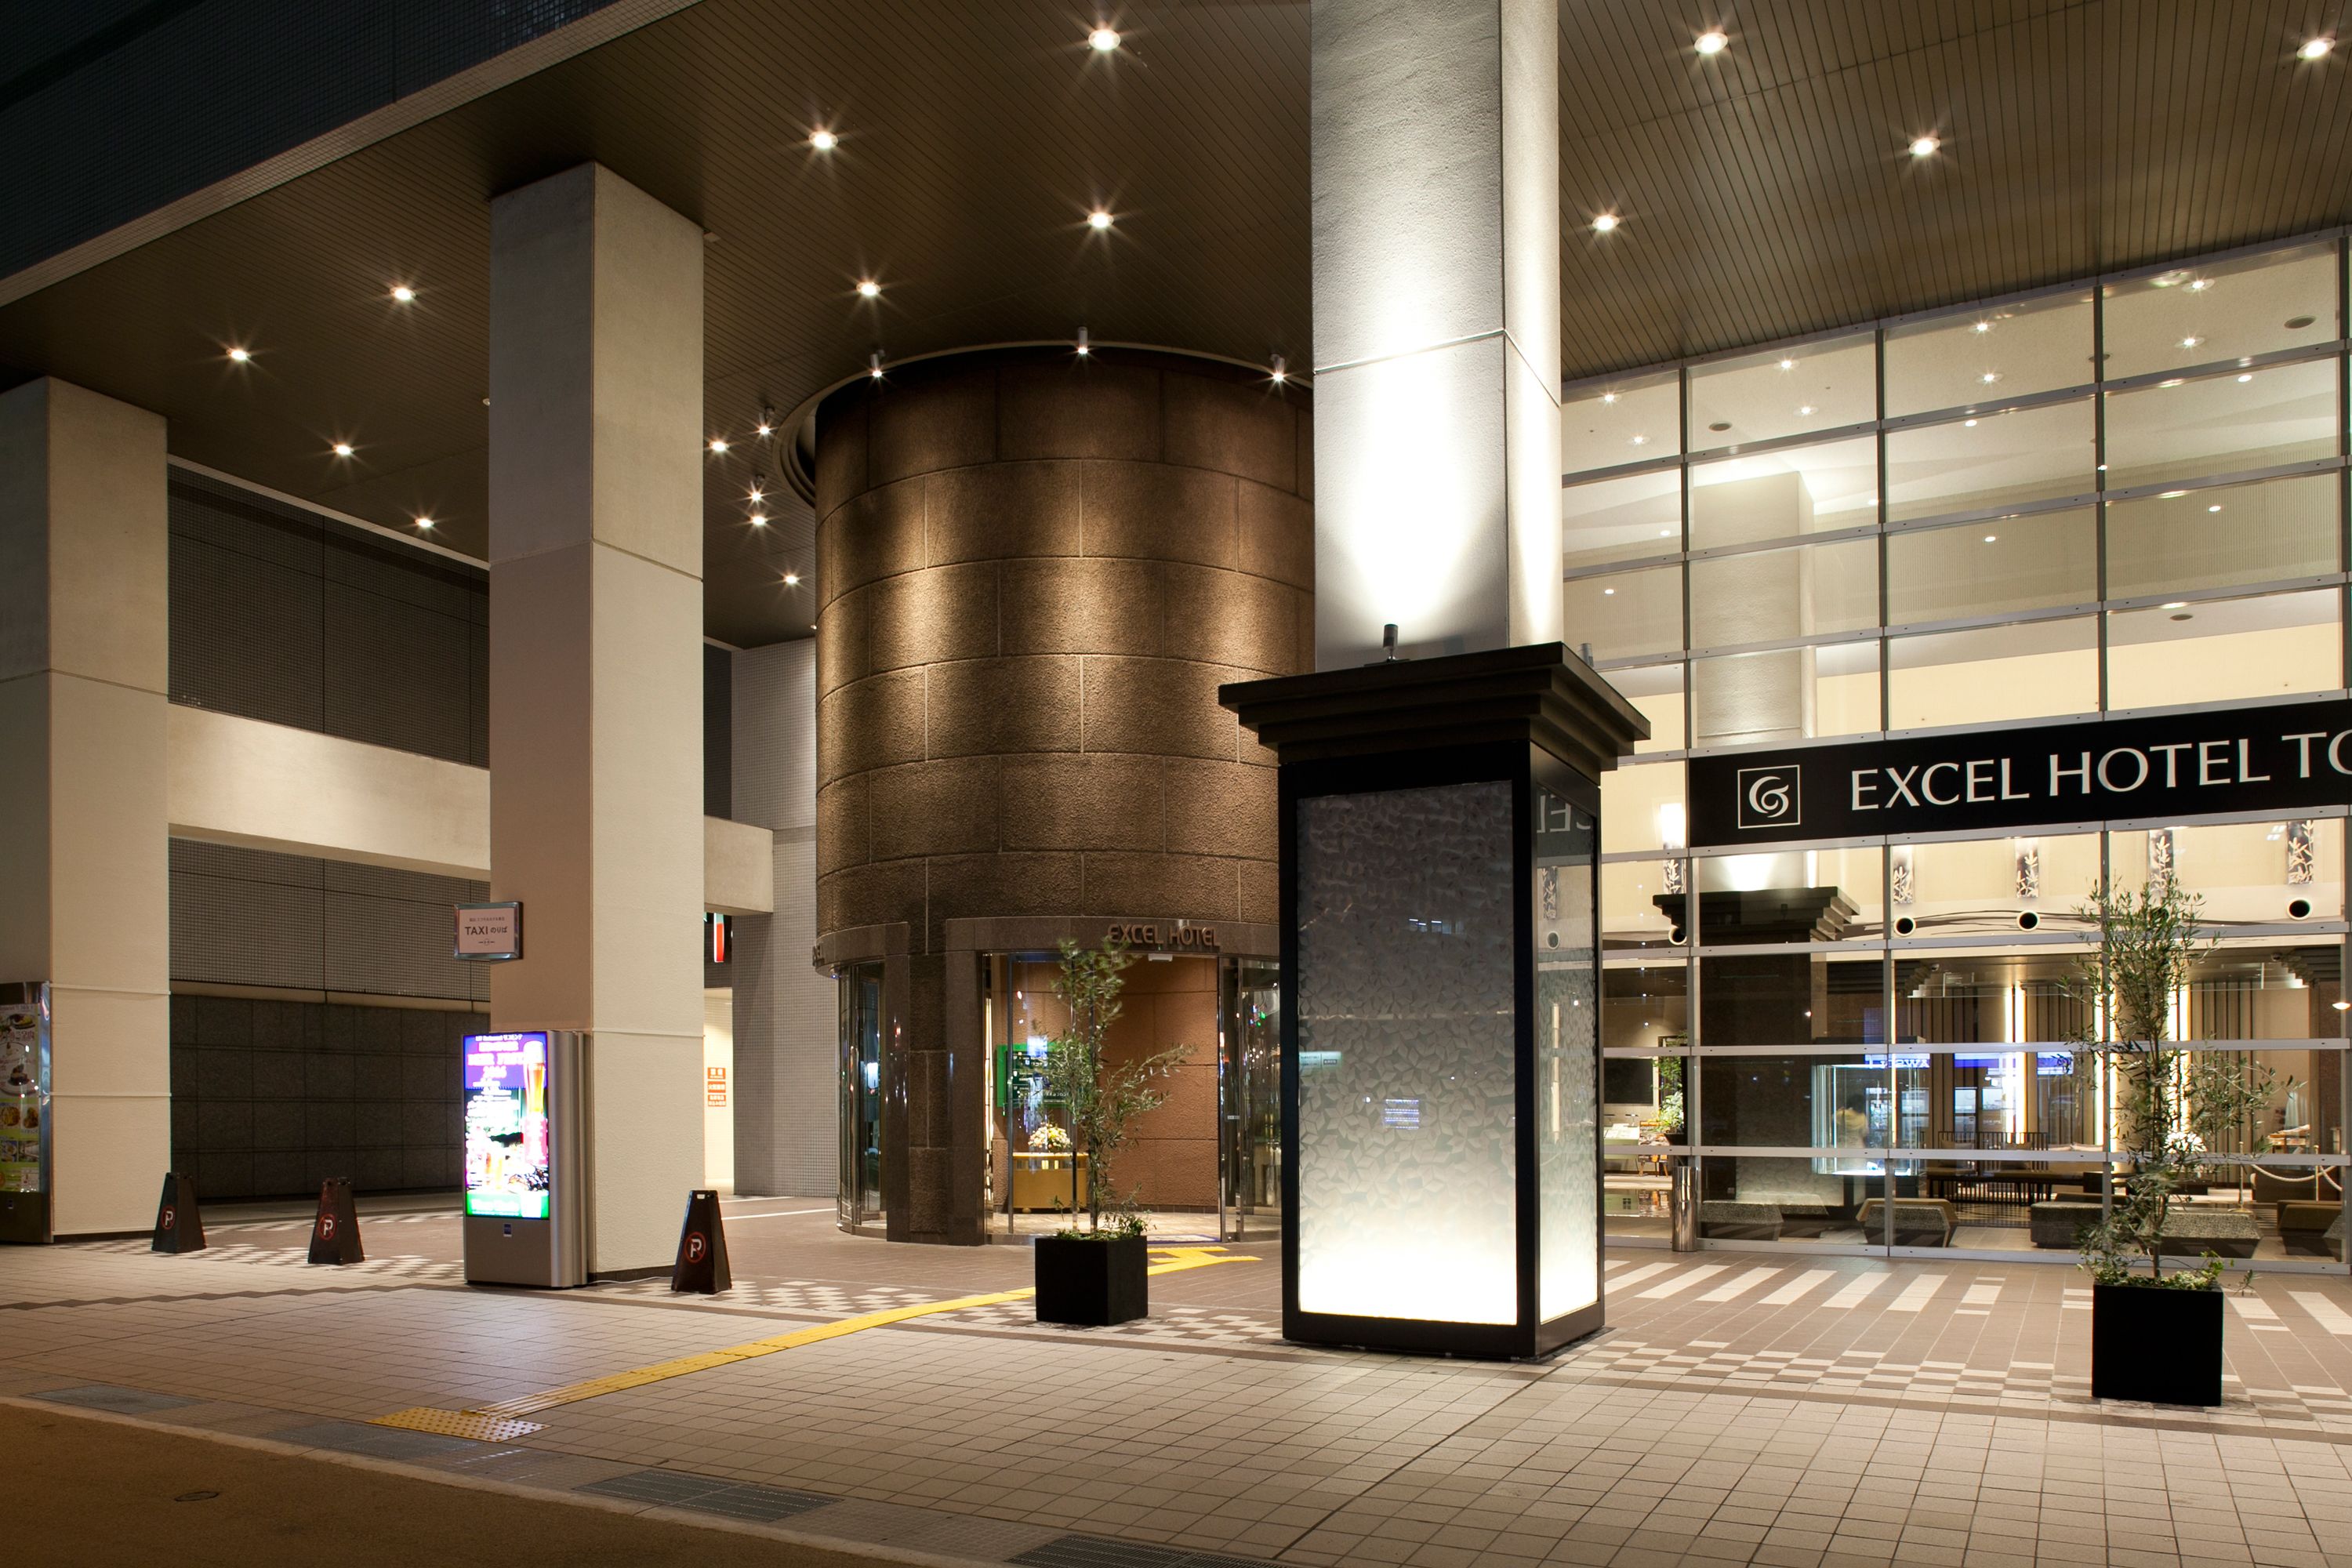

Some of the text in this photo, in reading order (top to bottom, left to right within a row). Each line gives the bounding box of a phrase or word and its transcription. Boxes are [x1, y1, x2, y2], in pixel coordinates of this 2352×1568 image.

[1852, 758, 2030, 811] EXCEL
[2049, 739, 2270, 797] HOTEL
[464, 926, 488, 935] TAXI
[1108, 924, 1220, 947] EXCEL HOTEL
